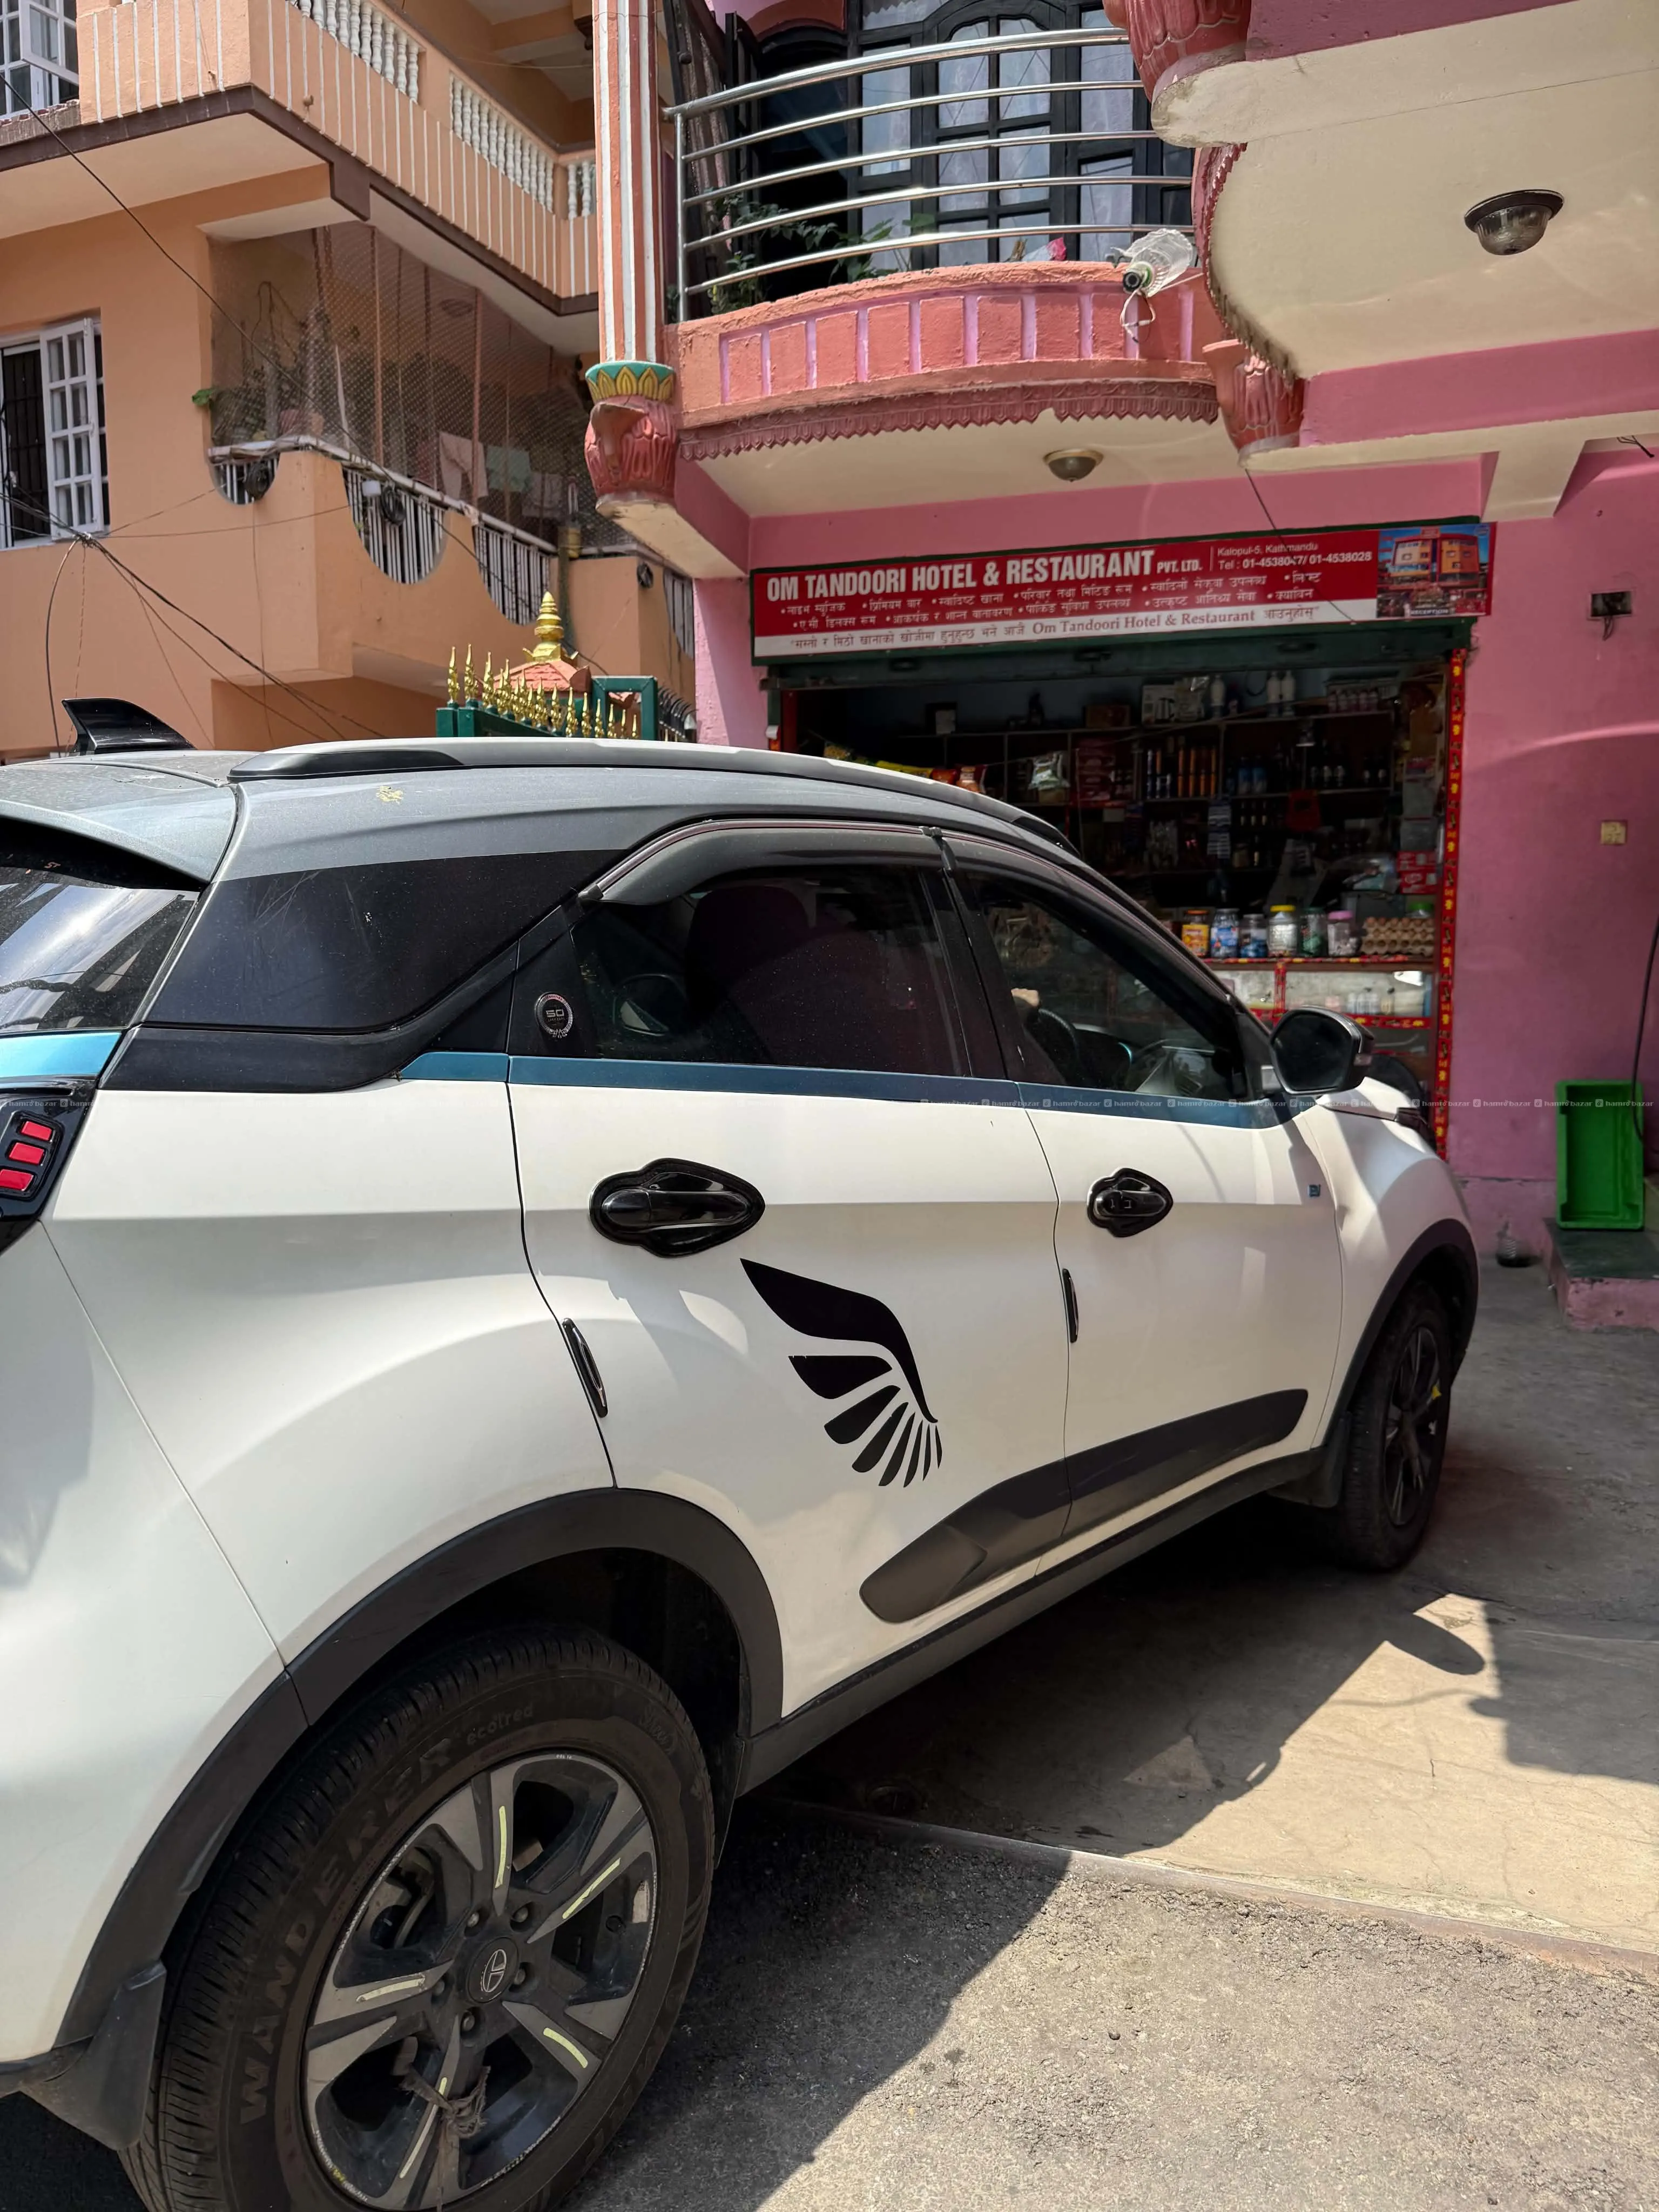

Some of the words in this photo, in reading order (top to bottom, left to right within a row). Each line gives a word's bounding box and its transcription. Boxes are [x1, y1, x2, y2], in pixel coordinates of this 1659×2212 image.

[1265, 542, 1319, 554] Kathmandu
[767, 576, 799, 602] OM
[805, 568, 906, 599] TANDOORI
[912, 563, 977, 592] HOTEL
[983, 561, 1000, 586] &
[1006, 550, 1155, 585] RESTAURANT
[980, 593, 1003, 604] खाना
[1033, 622, 1056, 635] Om
[1061, 618, 1120, 633] Tandoori
[1124, 615, 1161, 629] Hotel
[1165, 615, 1177, 626] &
[1182, 610, 1256, 625] Restaurant
